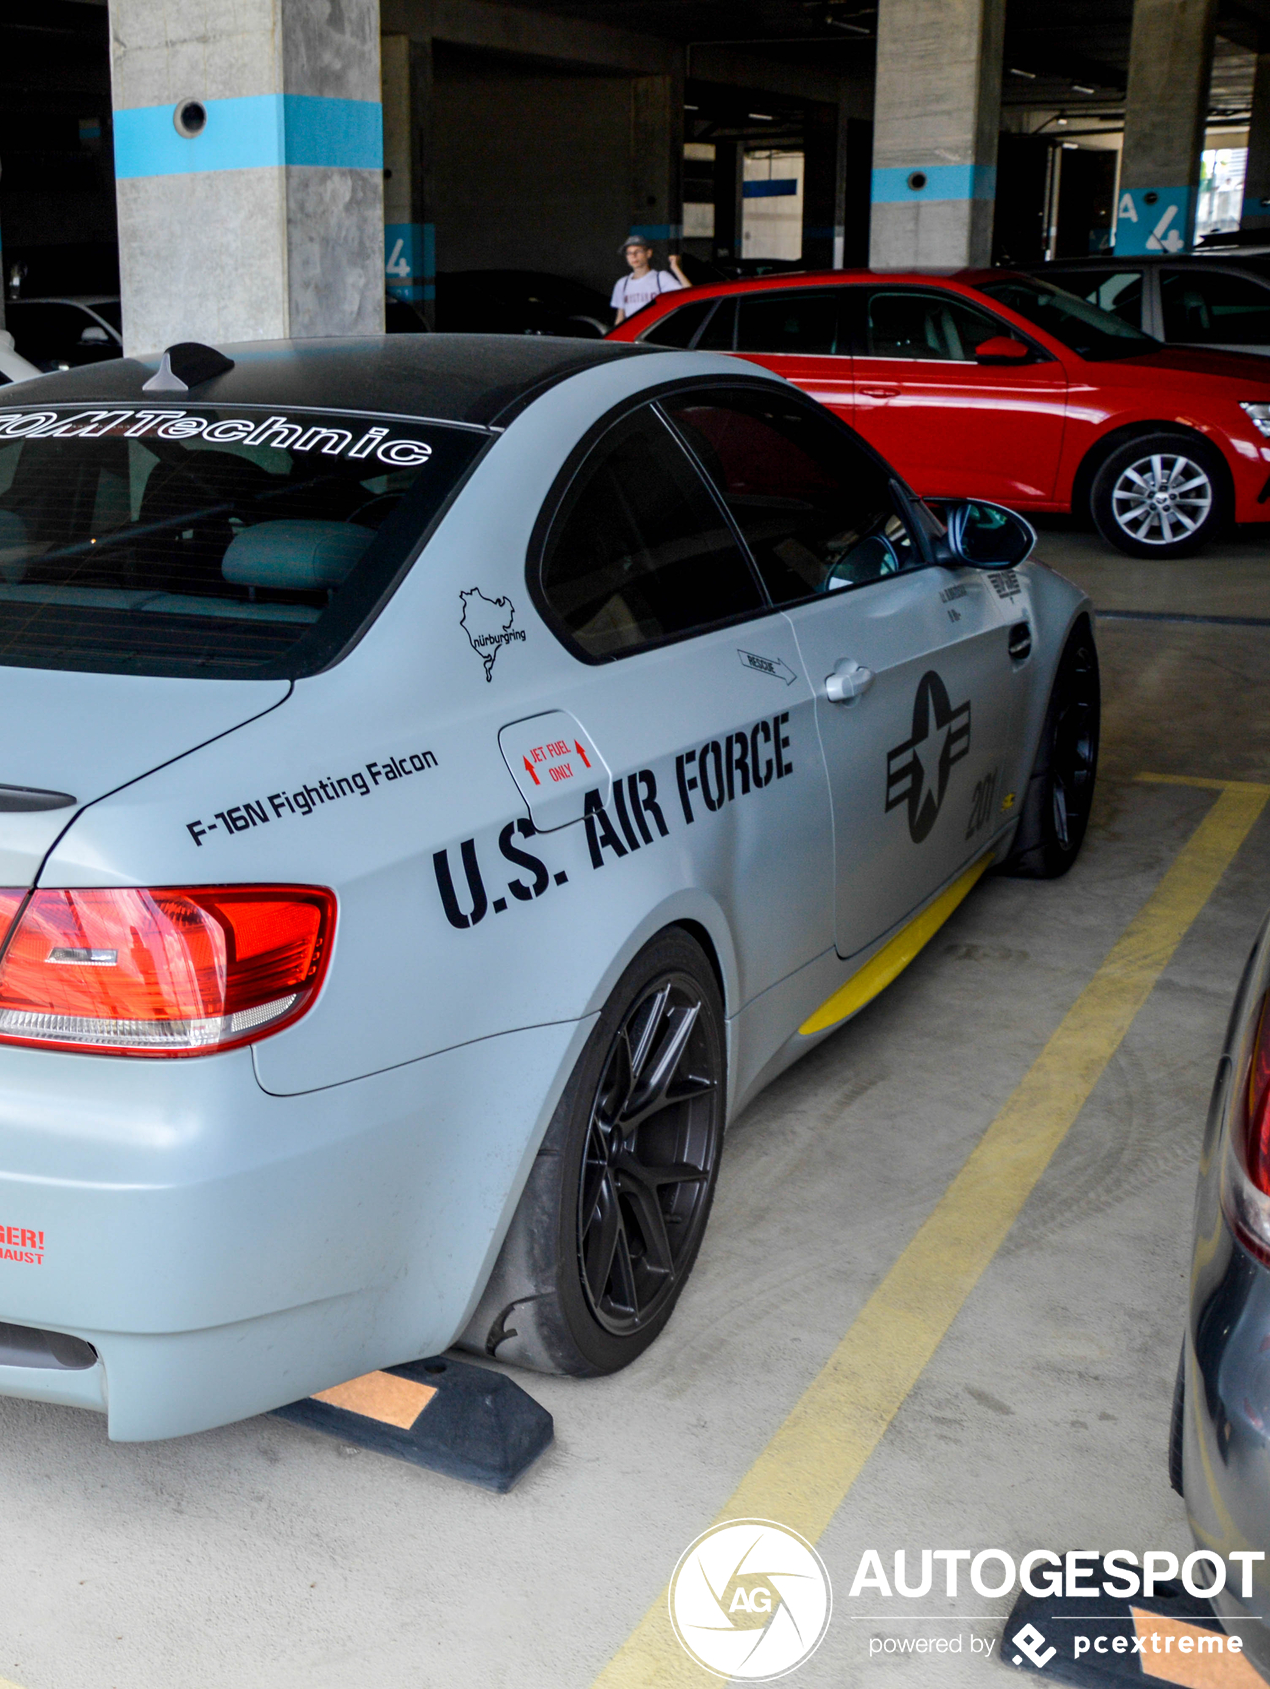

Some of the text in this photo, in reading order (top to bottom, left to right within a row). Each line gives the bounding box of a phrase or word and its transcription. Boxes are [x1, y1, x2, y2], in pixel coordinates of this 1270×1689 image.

[1119, 193, 1138, 222] A
[1146, 205, 1184, 252] 4
[386, 239, 410, 277] 4
[474, 629, 526, 648] nürburgring
[747, 655, 776, 674] RESCUE
[531, 740, 572, 764] JET FUEL
[549, 763, 574, 783] ONLY
[186, 750, 439, 847] F-16N Fighting Falcon
[432, 711, 794, 929] U.S. AIR FORCE
